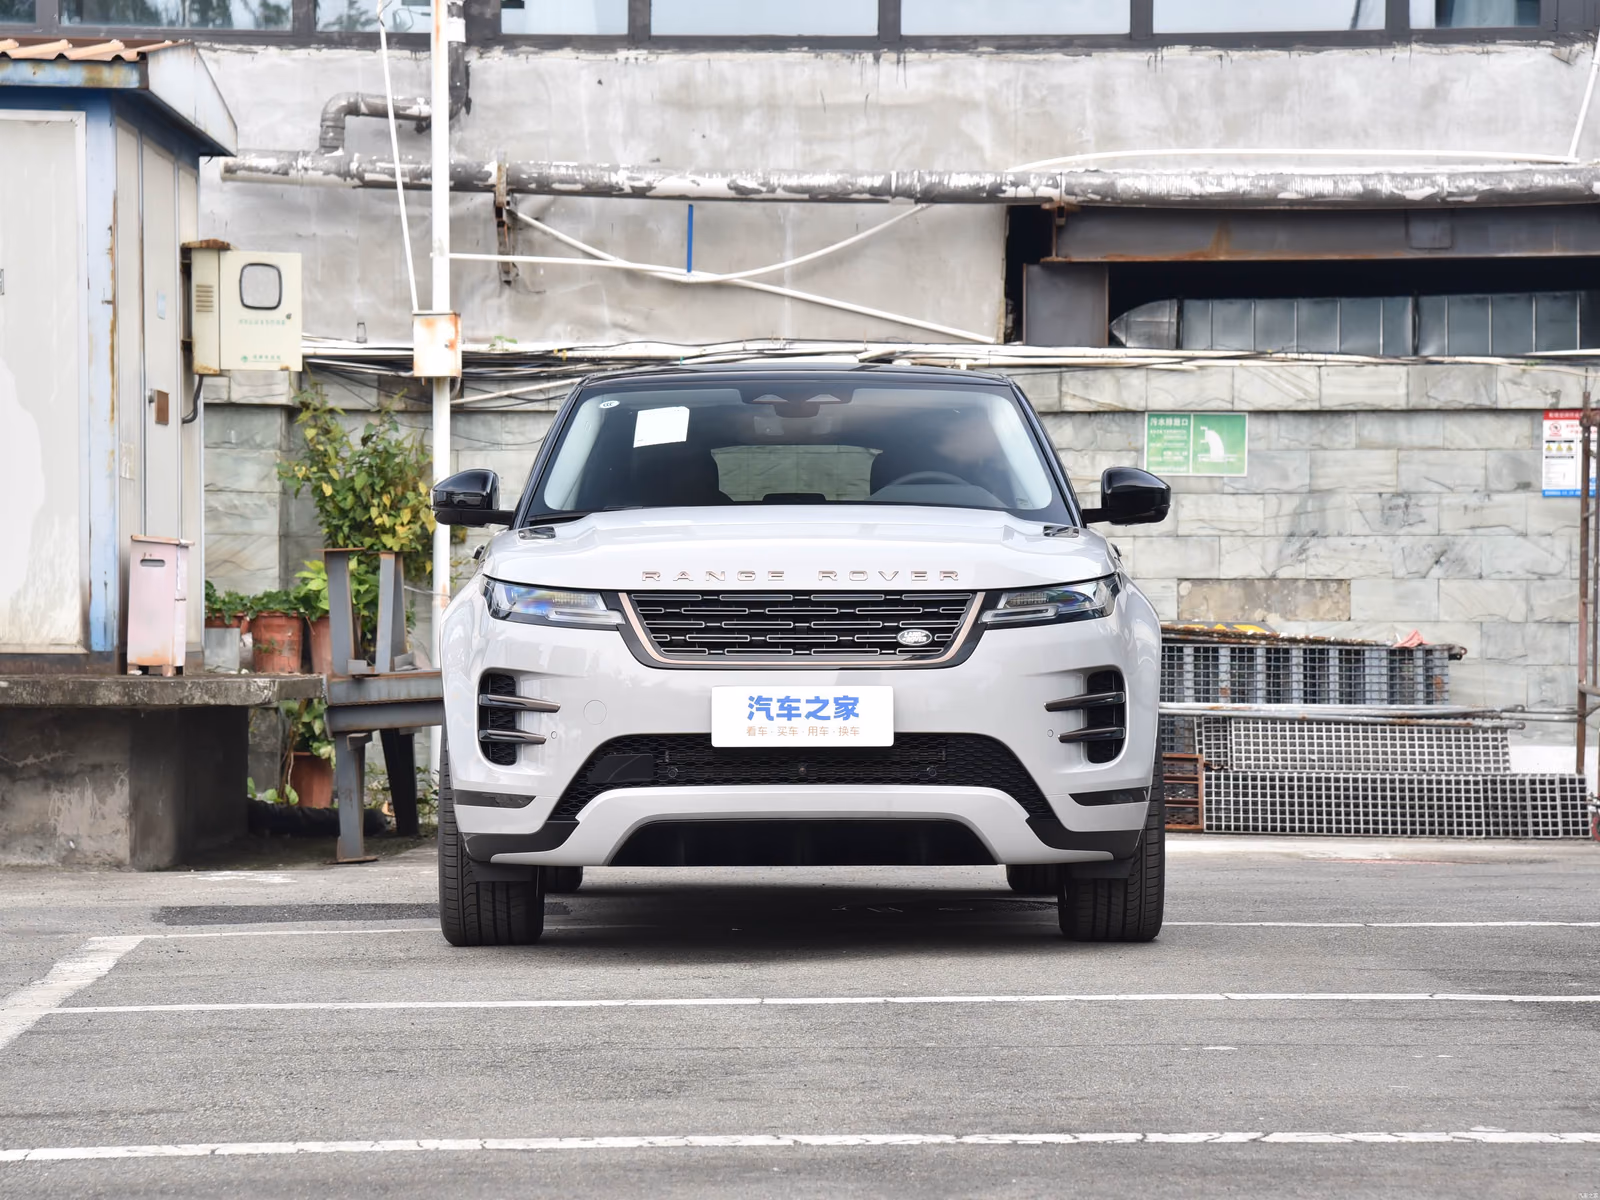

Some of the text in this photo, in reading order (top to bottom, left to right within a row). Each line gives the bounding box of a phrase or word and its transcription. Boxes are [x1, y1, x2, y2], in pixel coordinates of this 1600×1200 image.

[641, 570, 959, 582] RANGE ROVER
[747, 695, 860, 722] 汽车之家
